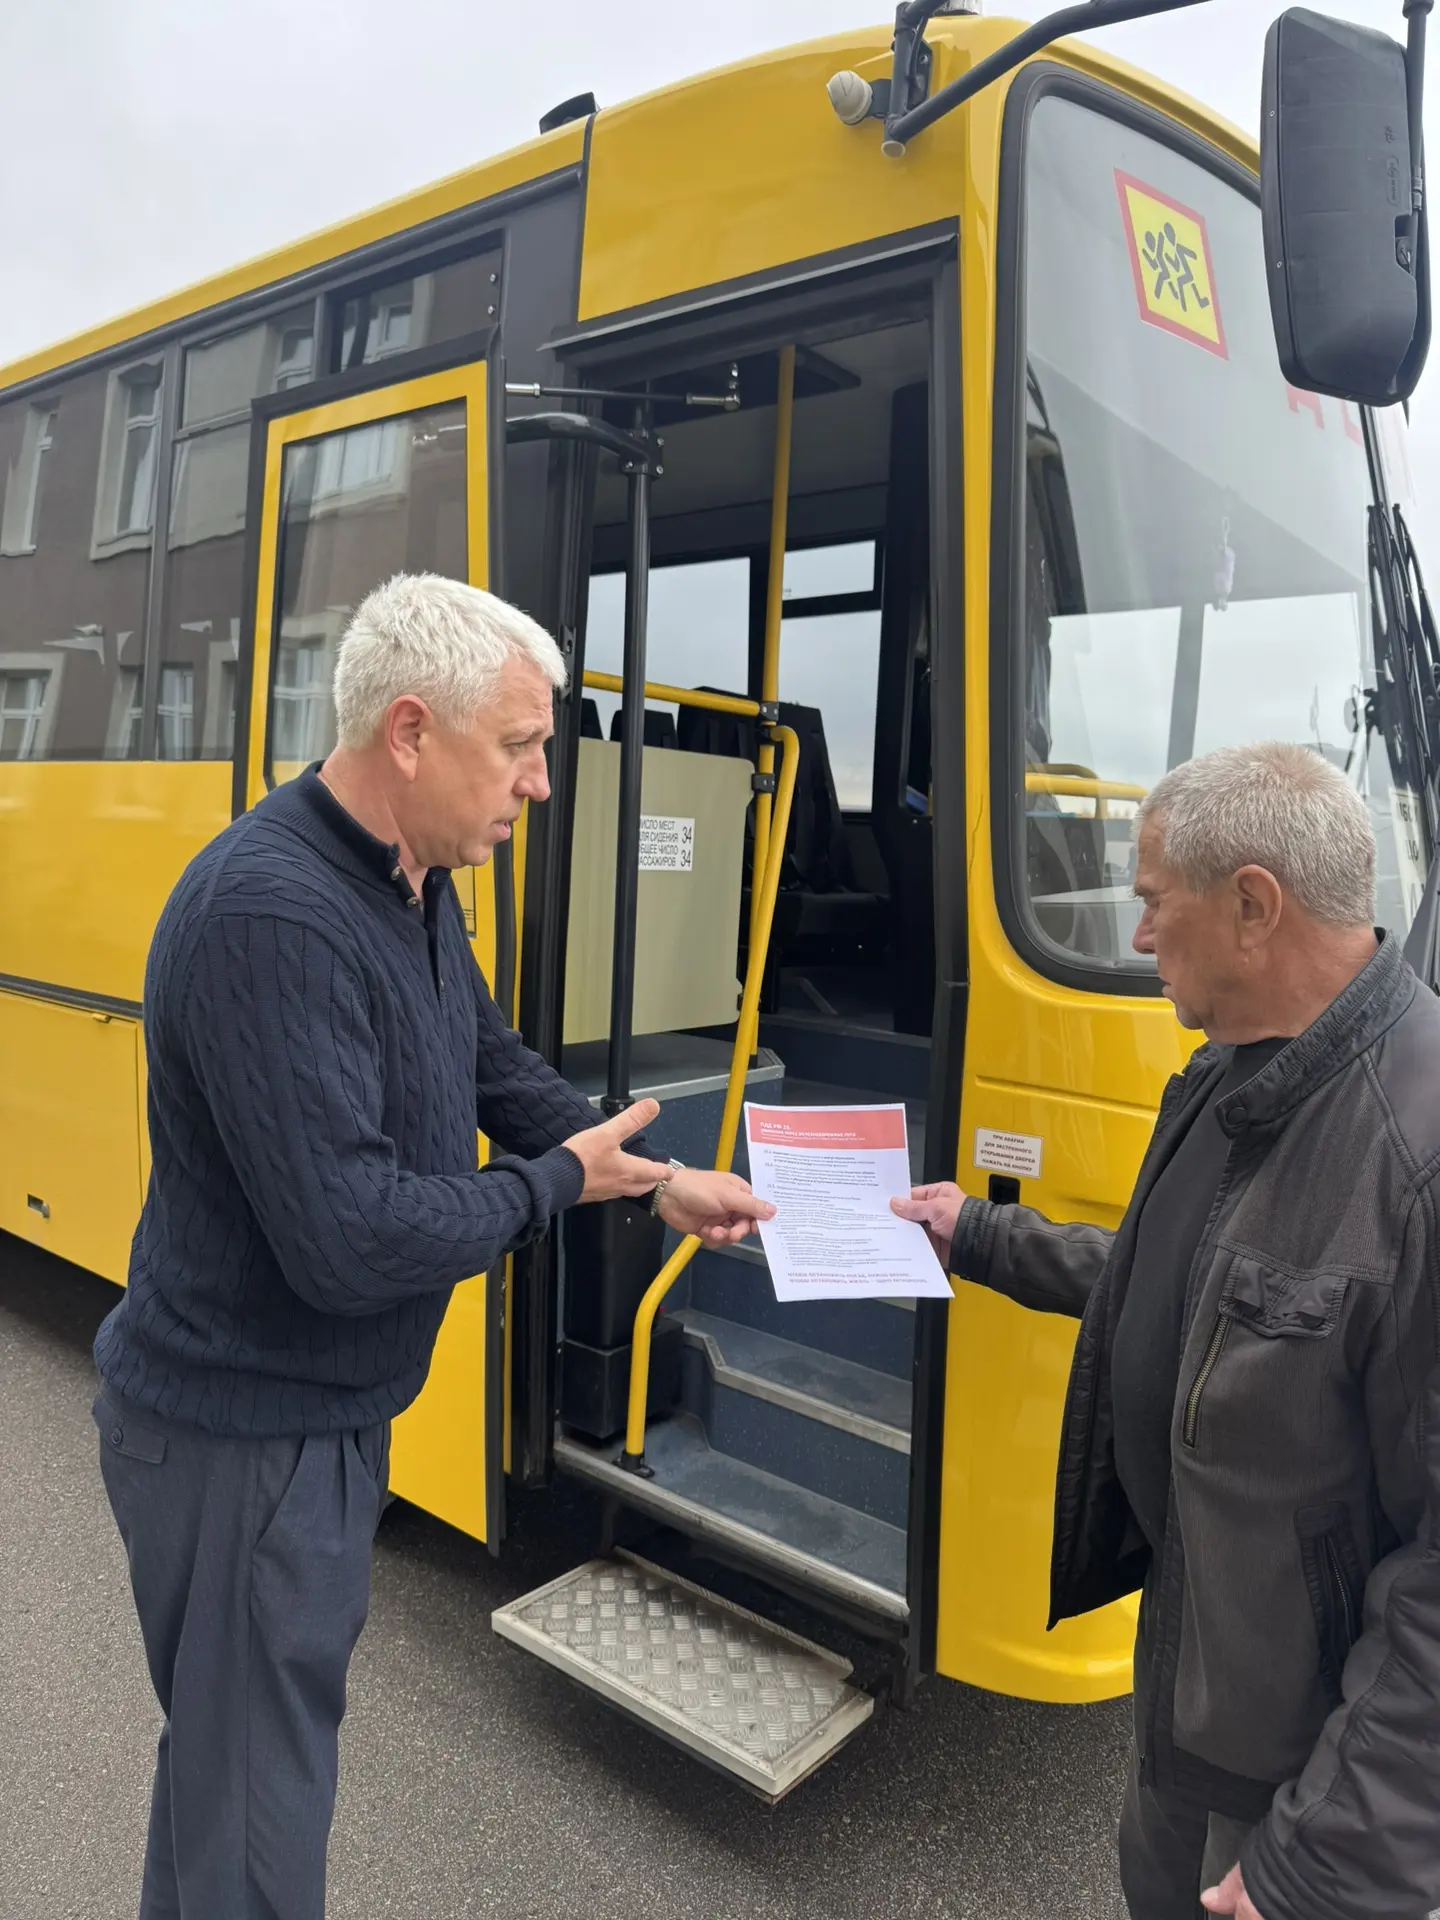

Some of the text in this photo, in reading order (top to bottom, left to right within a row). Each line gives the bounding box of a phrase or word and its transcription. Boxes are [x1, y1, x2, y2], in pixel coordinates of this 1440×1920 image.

[640, 819, 676, 831] ИСЛО МЕСТ
[639, 831, 679, 843] ЛЯ СИДЕНИЯ
[681, 826, 692, 844] 34
[639, 843, 679, 856] БЩЕЕ ЧИСЛО
[639, 855, 677, 867] АССАЖИРОВ
[680, 849, 691, 867] 34
[1004, 1136, 1025, 1144] АВАРИИ
[982, 1158, 1003, 1166] НАЖАТЬ
[1012, 1164, 1032, 1172] КНОПКУ
[1015, 1156, 1036, 1164] ДВЕРЕЙ
